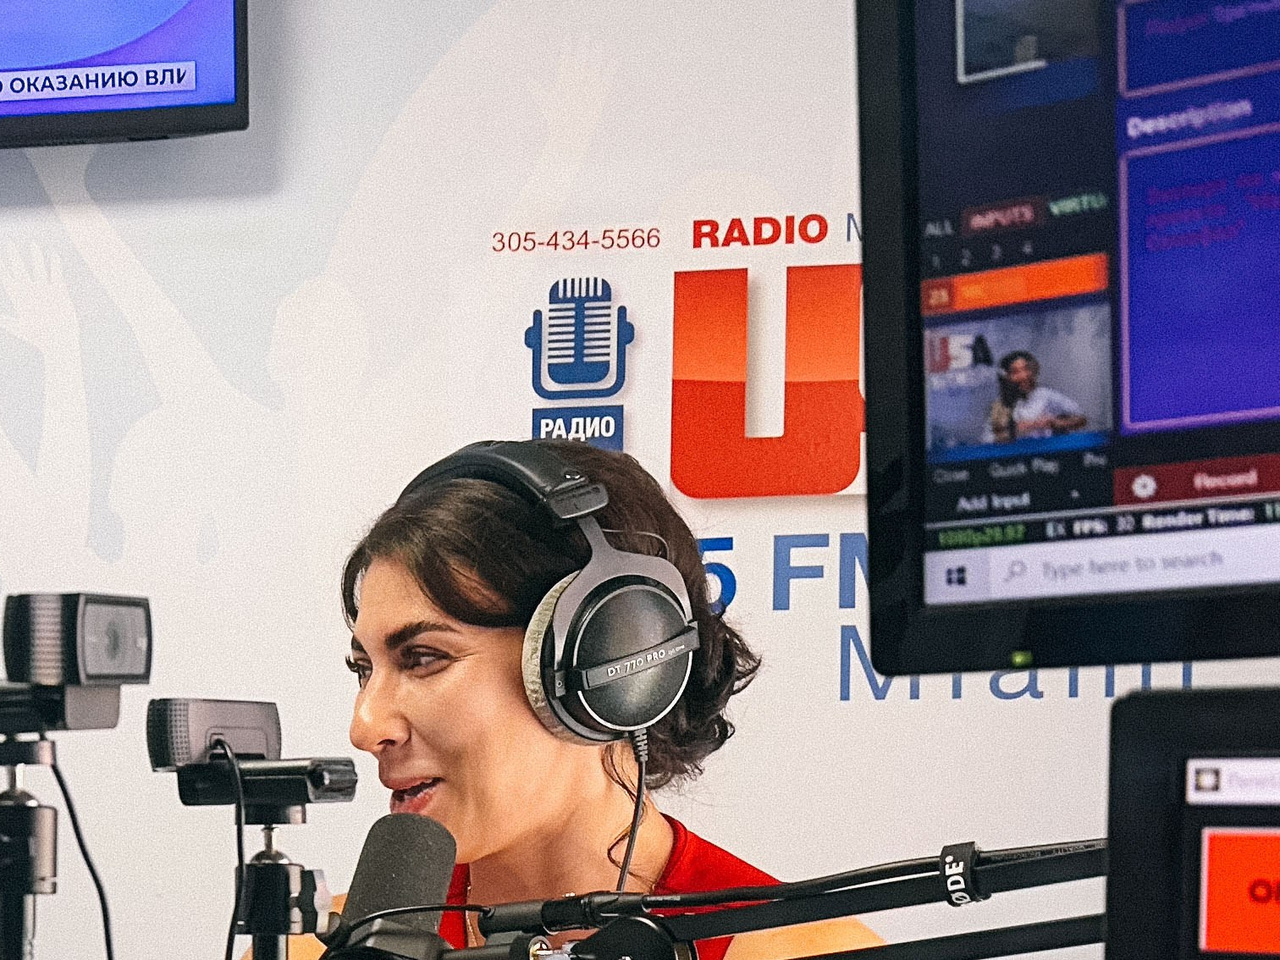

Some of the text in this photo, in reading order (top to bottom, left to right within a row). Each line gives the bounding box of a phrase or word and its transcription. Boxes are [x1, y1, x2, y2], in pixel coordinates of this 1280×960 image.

[9, 70, 138, 95] ОКАЗАНИЮ
[491, 227, 661, 252] 305-434-5566
[693, 213, 829, 249] RADIO
[540, 416, 615, 442] РАДИО
